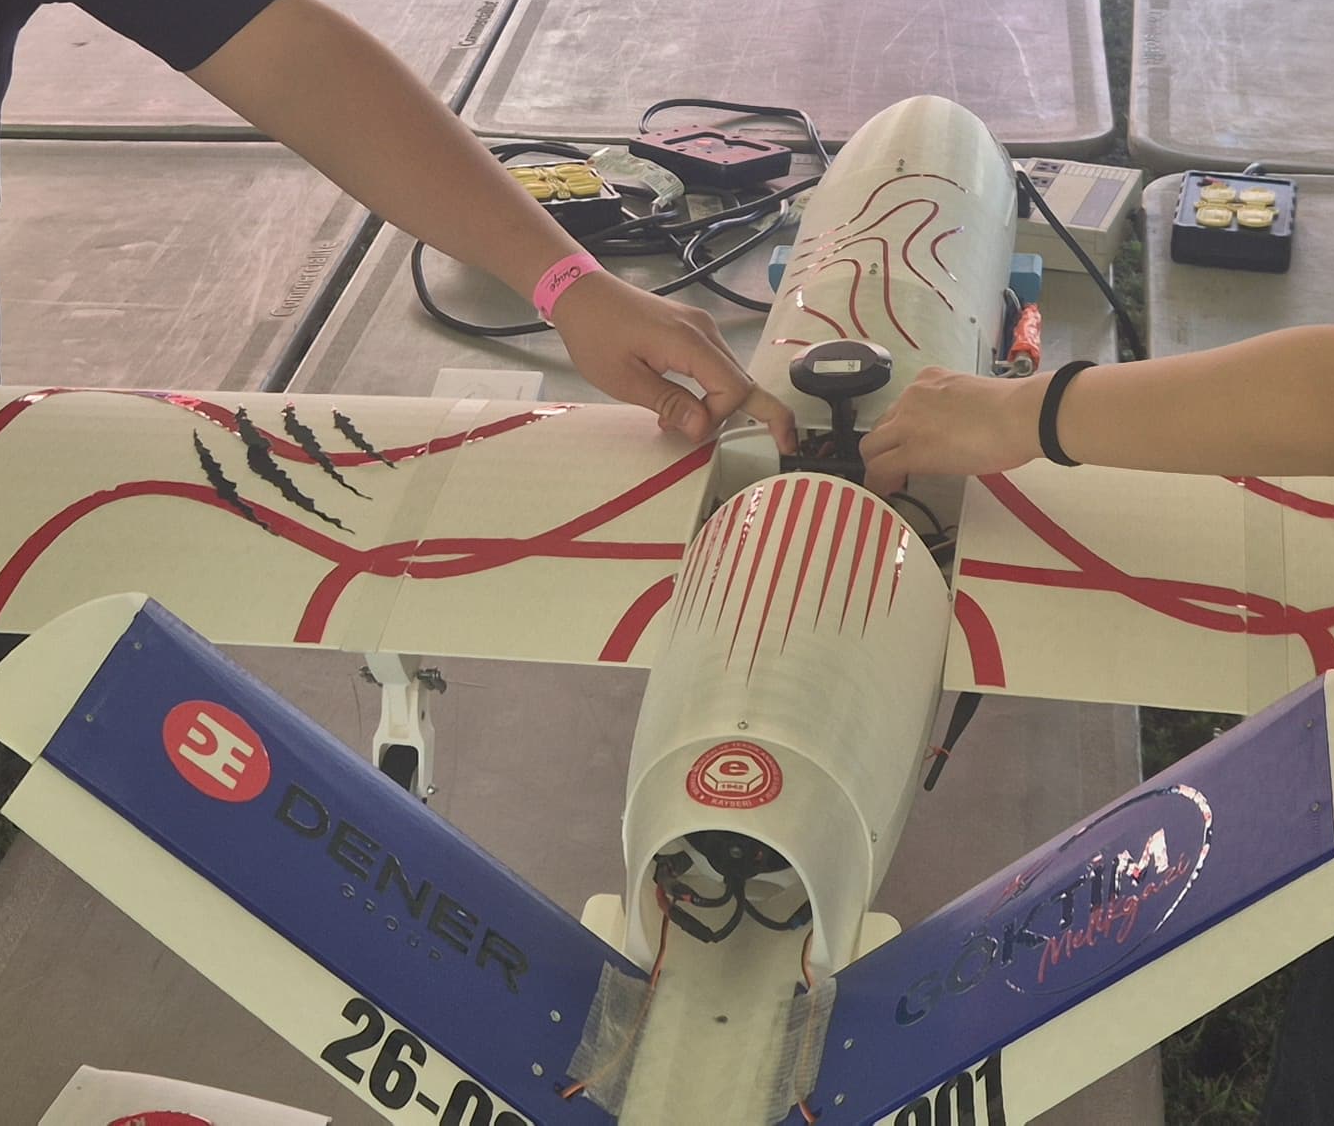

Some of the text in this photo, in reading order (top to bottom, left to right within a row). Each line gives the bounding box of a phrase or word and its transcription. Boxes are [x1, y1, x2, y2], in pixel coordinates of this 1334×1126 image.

[274, 782, 529, 996] DENER
[895, 827, 1170, 1027] GÖKTİM
[320, 997, 533, 1126] 26-0
